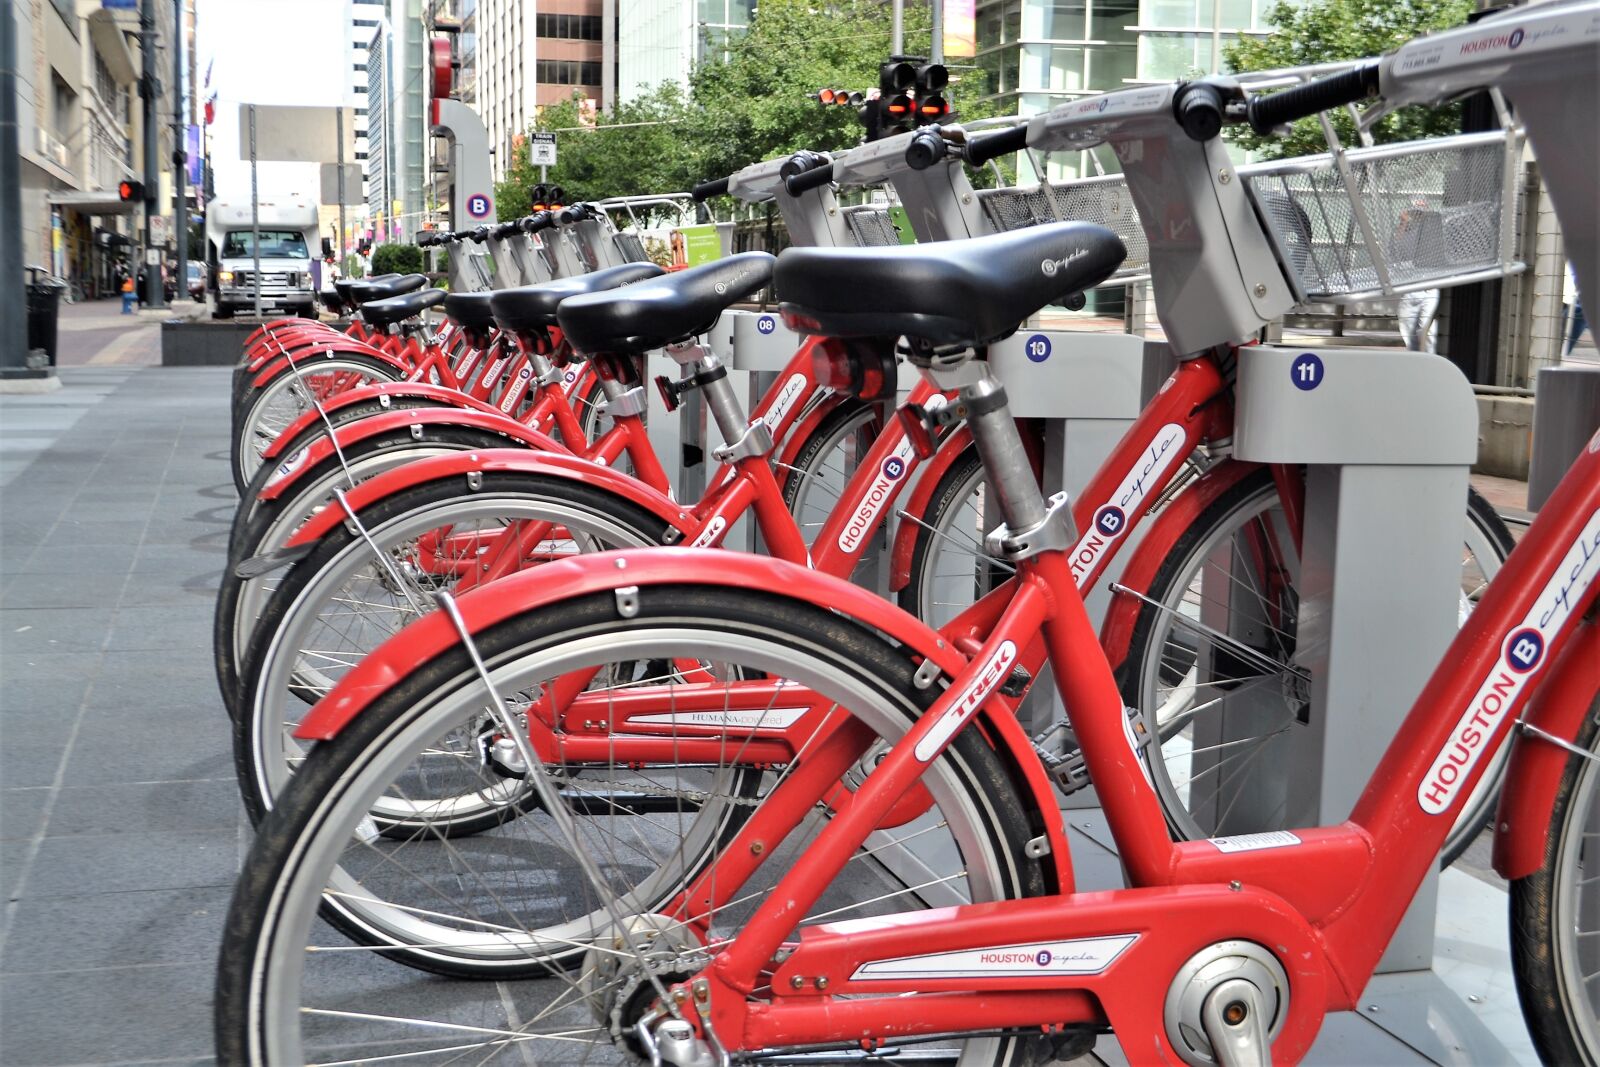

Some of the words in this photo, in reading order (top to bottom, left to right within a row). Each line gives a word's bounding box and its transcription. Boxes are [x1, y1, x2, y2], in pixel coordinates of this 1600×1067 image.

[1460, 36, 1508, 54] HOUSTON
[759, 319, 773, 331] 08
[1029, 341, 1046, 356] 10
[1297, 363, 1315, 381] 11
[503, 379, 524, 411] HOUSTON
[842, 479, 890, 548] HOUSTON
[951, 649, 1010, 717] TREK
[1424, 672, 1516, 806] HOUSTON
[981, 953, 1034, 964] HOUSTON
